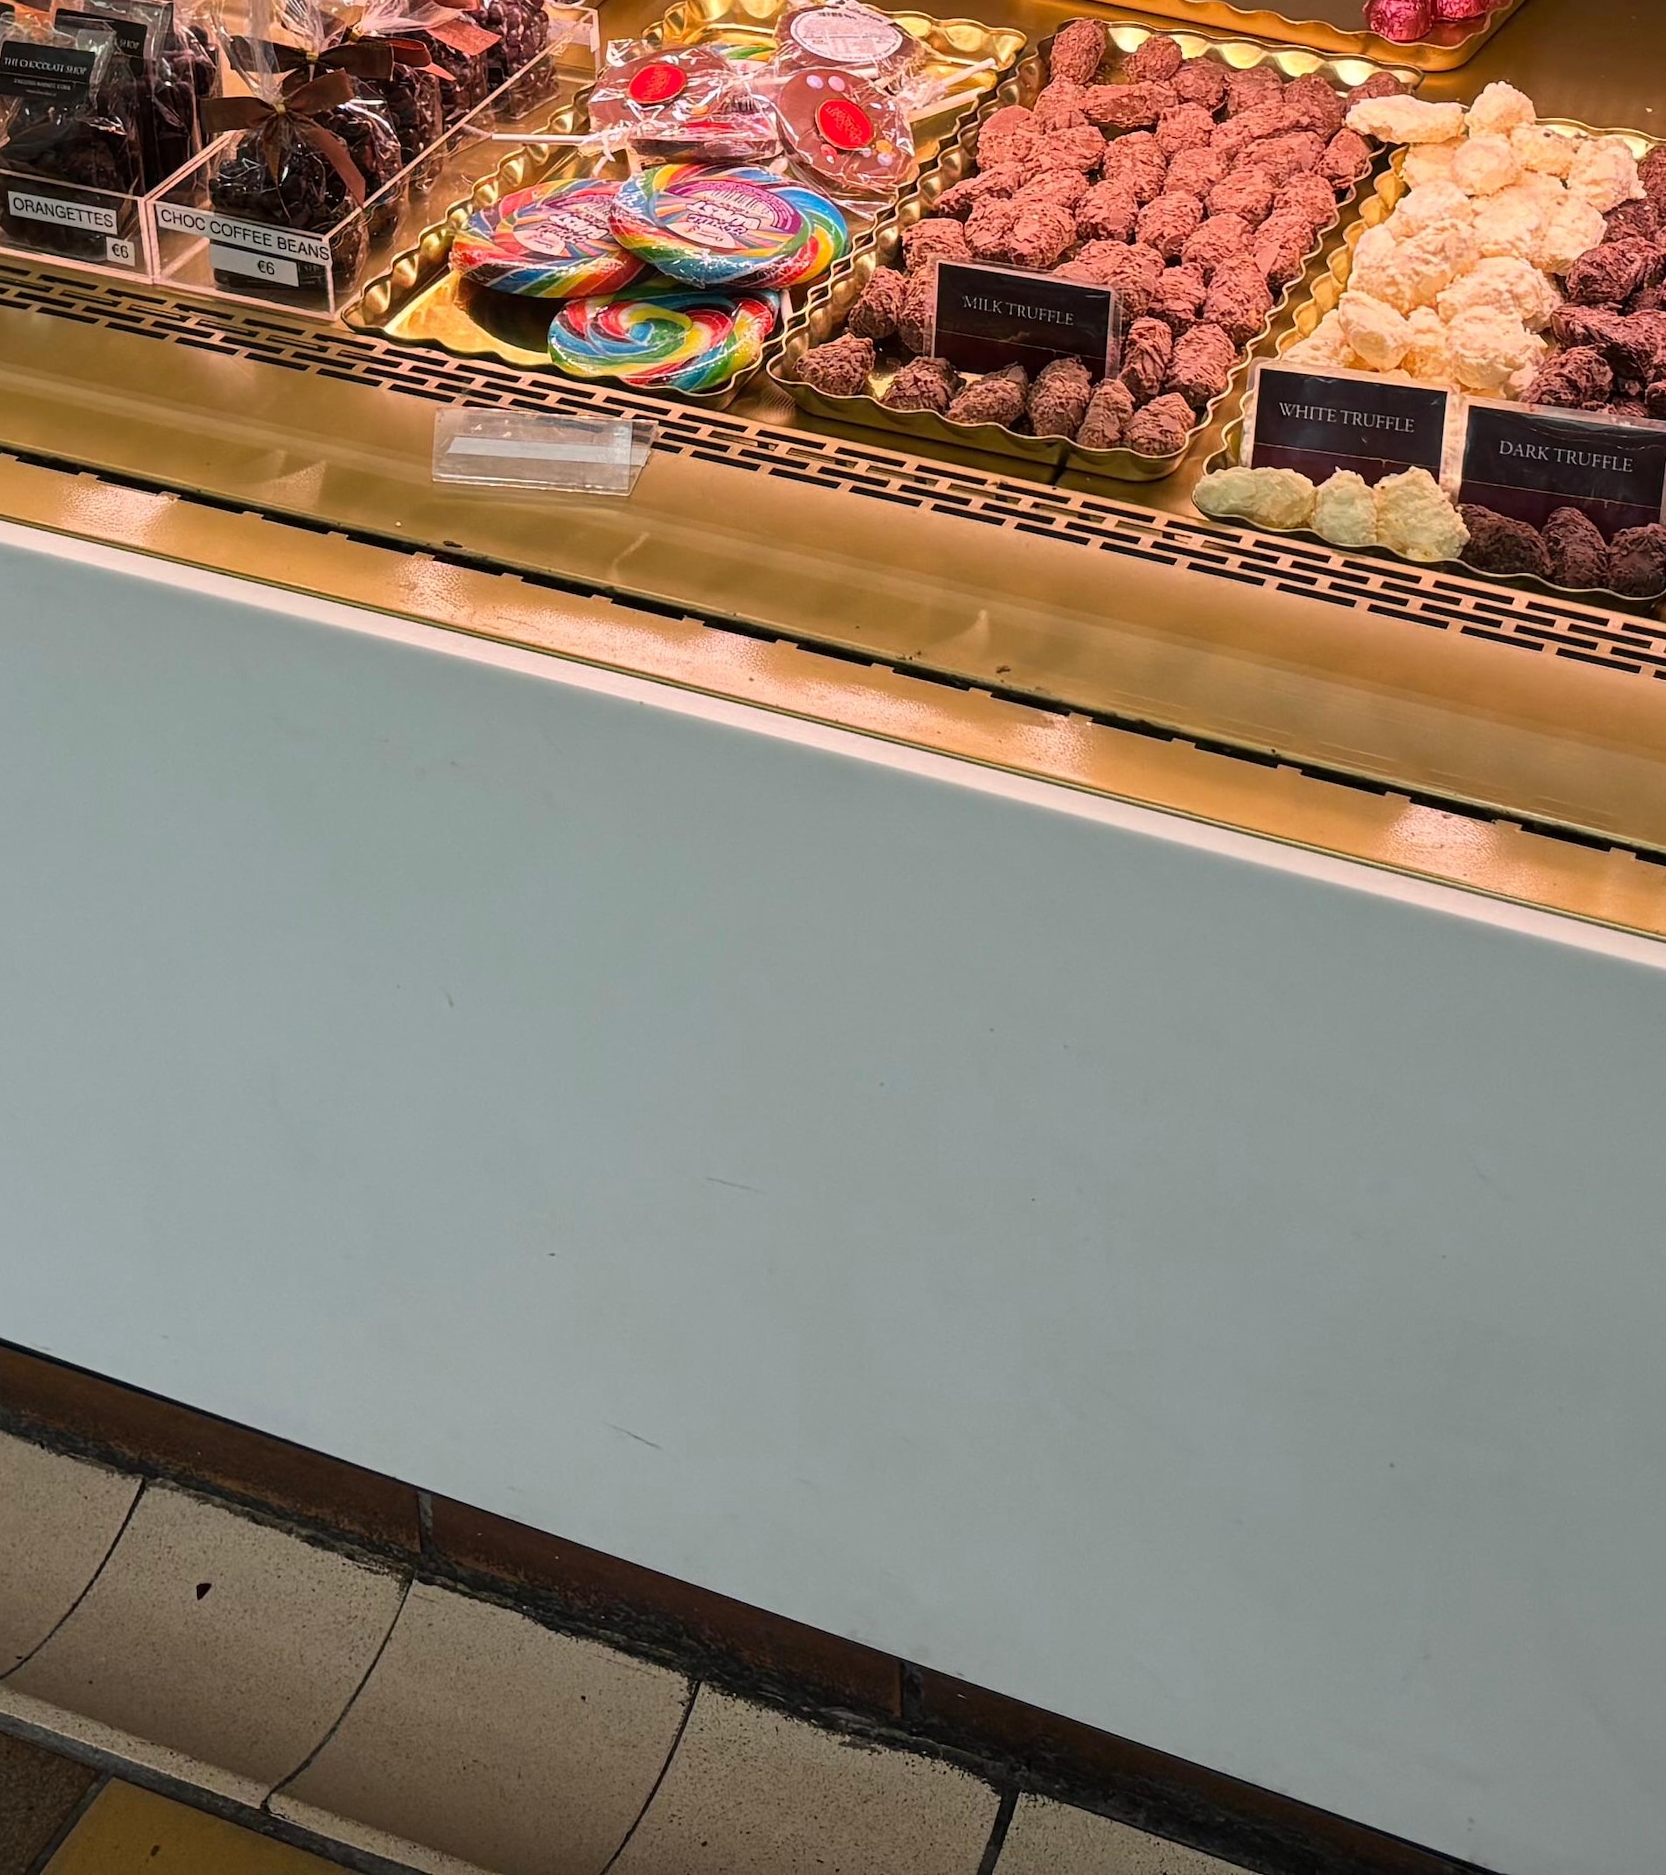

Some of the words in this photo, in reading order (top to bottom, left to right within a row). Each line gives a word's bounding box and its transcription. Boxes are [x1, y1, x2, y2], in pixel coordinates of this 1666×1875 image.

[12, 196, 114, 230] ORANGETTES
[110, 240, 129, 261] €6
[160, 208, 208, 231] CHOC
[209, 219, 275, 246] COFFEE
[277, 231, 330, 260] BEANS
[255, 258, 276, 278] €6
[962, 295, 1002, 317] MILK
[1007, 300, 1076, 327] TRUFFLE
[1278, 400, 1337, 424] WHITE
[1340, 408, 1416, 435] TRUFFLE
[1499, 438, 1549, 463] DARK
[1553, 447, 1634, 474] TRUFFLE
